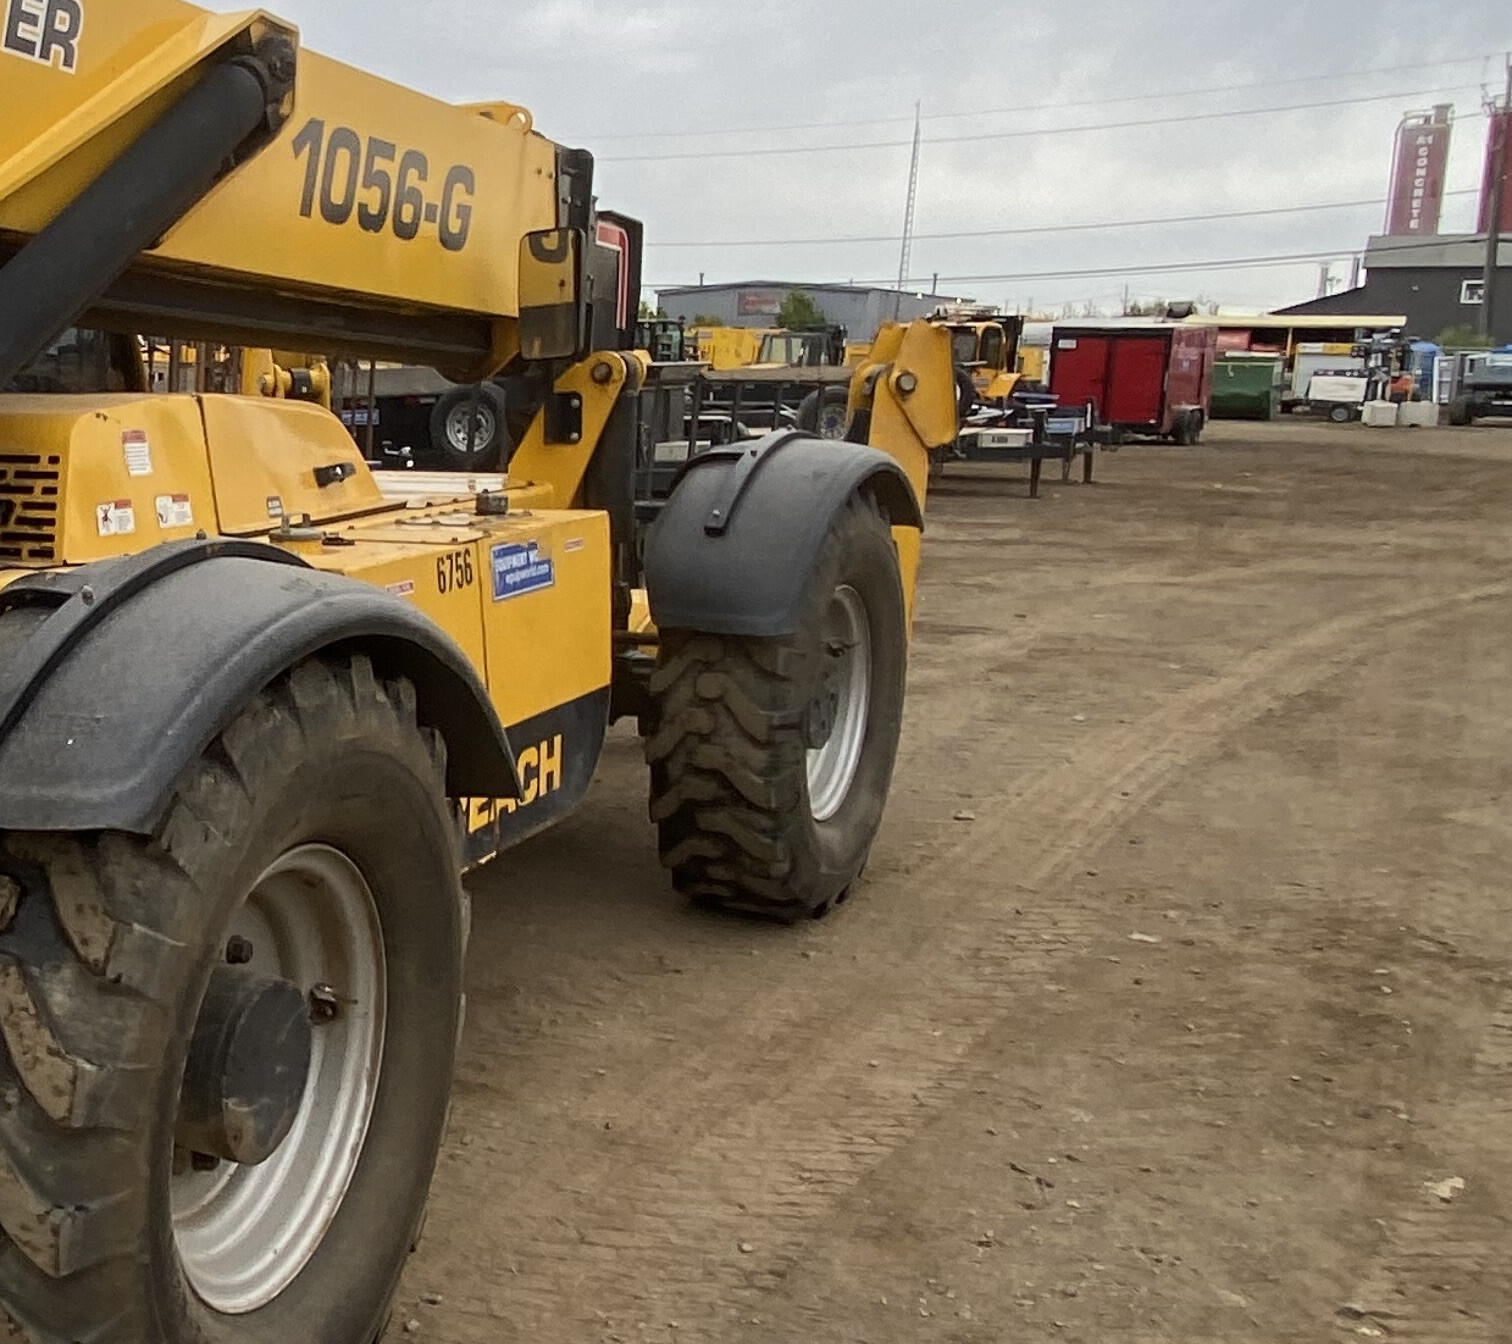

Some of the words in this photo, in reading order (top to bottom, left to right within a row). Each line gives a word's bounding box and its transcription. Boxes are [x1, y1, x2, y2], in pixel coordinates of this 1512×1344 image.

[291, 117, 475, 252] 1056-G
[1409, 146, 1428, 229] CONCRETE
[436, 548, 473, 594] 6756
